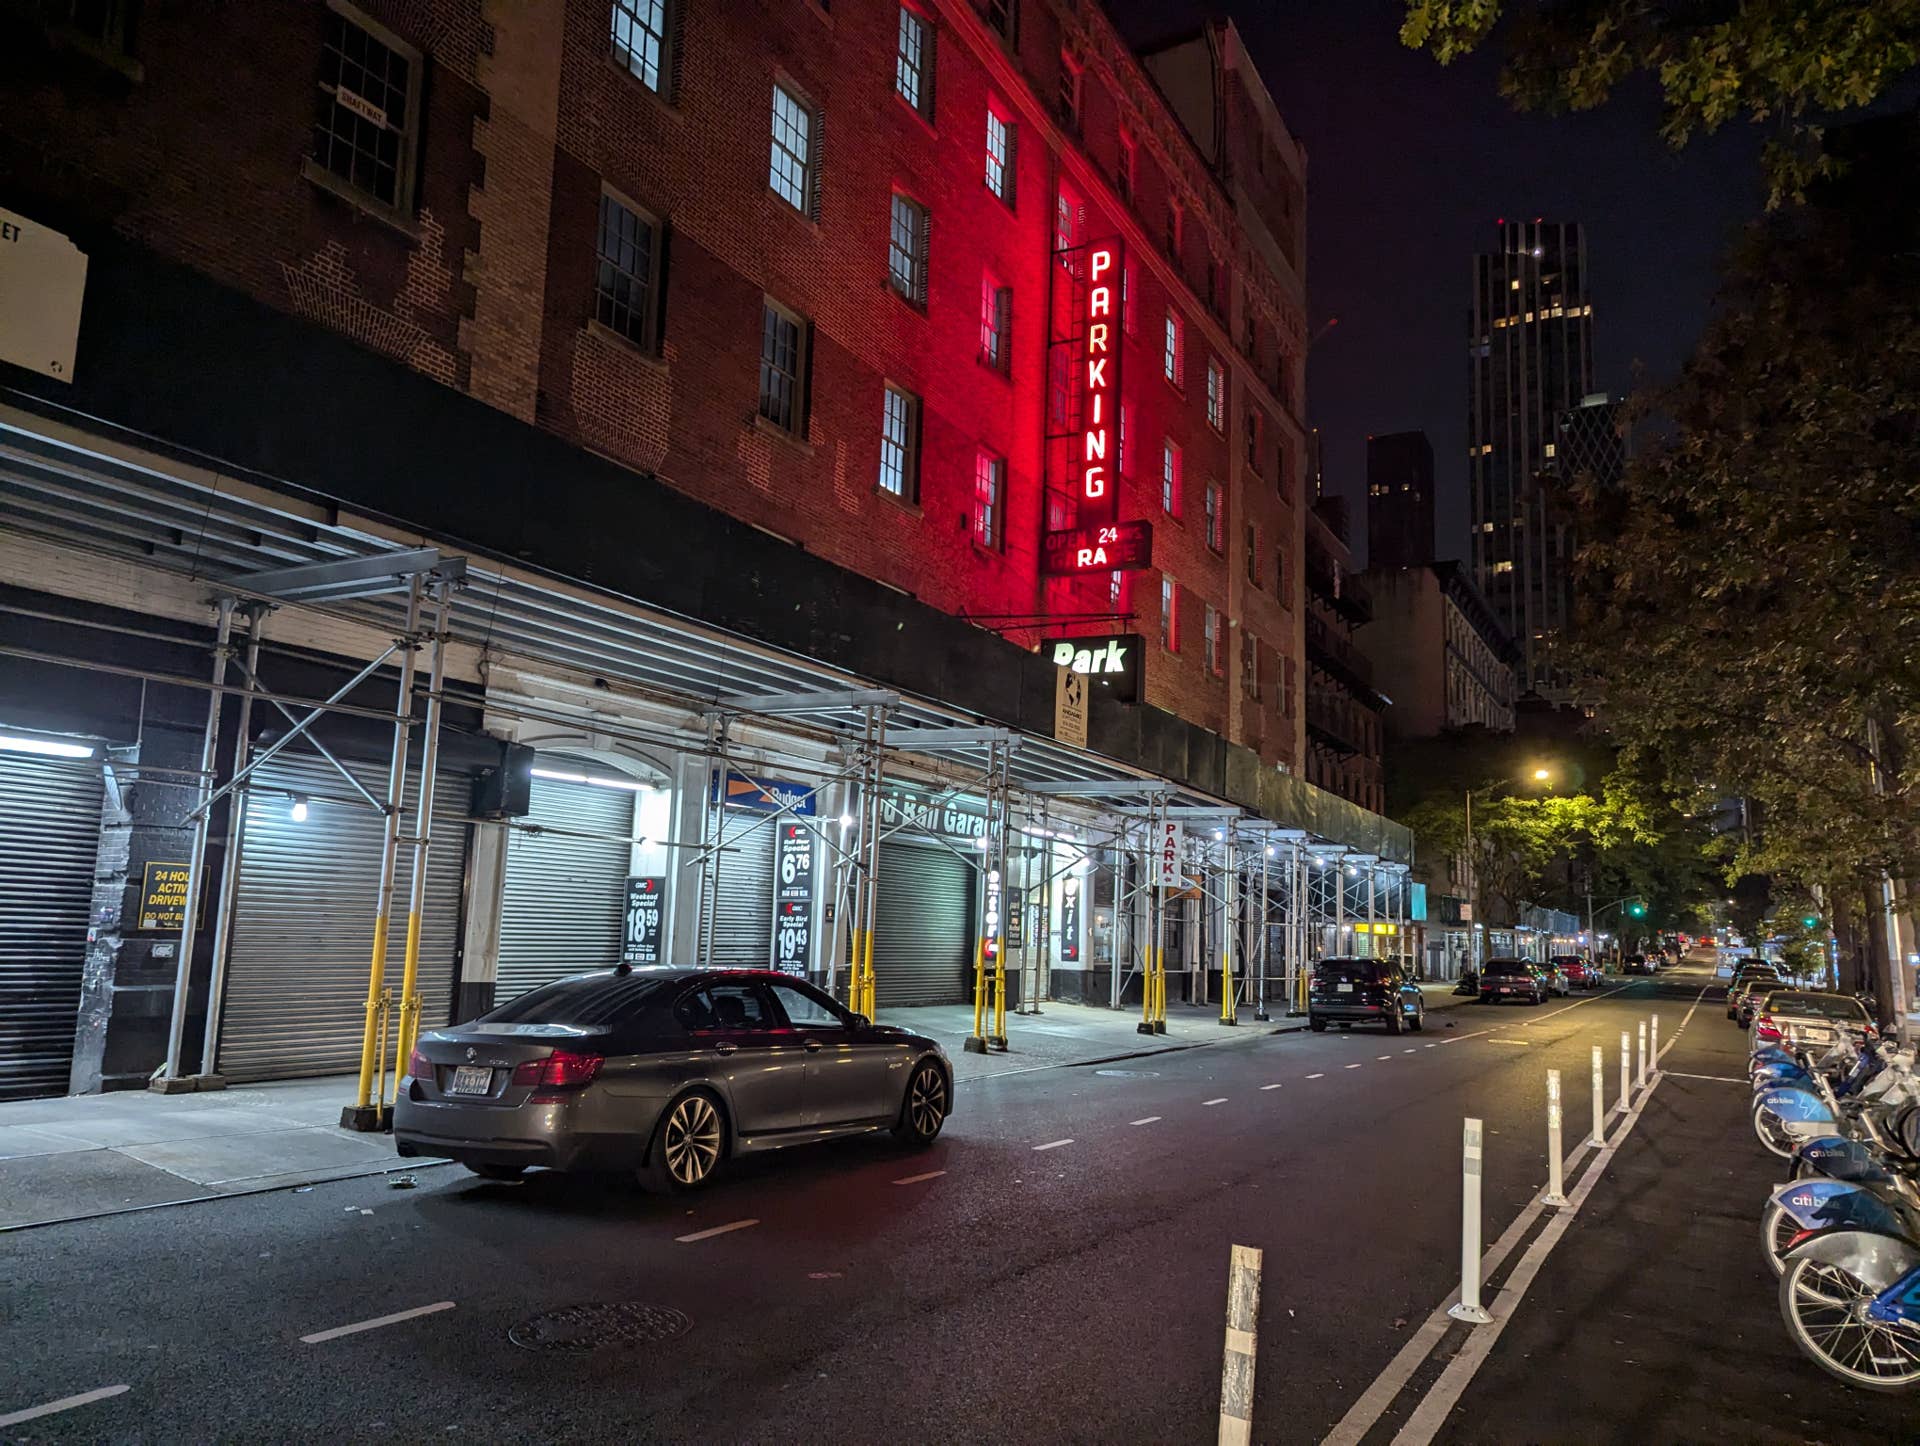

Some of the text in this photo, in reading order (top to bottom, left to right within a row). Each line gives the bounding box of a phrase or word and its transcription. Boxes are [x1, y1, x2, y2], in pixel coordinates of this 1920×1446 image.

[0, 220, 22, 243] ET
[1084, 250, 1111, 498] PARKING
[1098, 526, 1119, 544] 24
[1052, 640, 1128, 674] Park
[771, 787, 807, 811] Budget
[902, 794, 940, 830] Ball
[783, 844, 810, 853] Special
[1162, 823, 1177, 875] PARK
[155, 870, 190, 882] 24 HOU
[781, 853, 796, 884] 6
[157, 882, 188, 893] ACTIV
[630, 892, 659, 901] Weekend
[148, 894, 186, 906] DRIVEW
[631, 900, 656, 908] Special
[1064, 877, 1079, 940] exit
[144, 912, 157, 920] DO
[157, 912, 175, 920] NOT
[627, 908, 645, 942] 18
[778, 928, 796, 959] 19
[1791, 1195, 1812, 1207] citi
